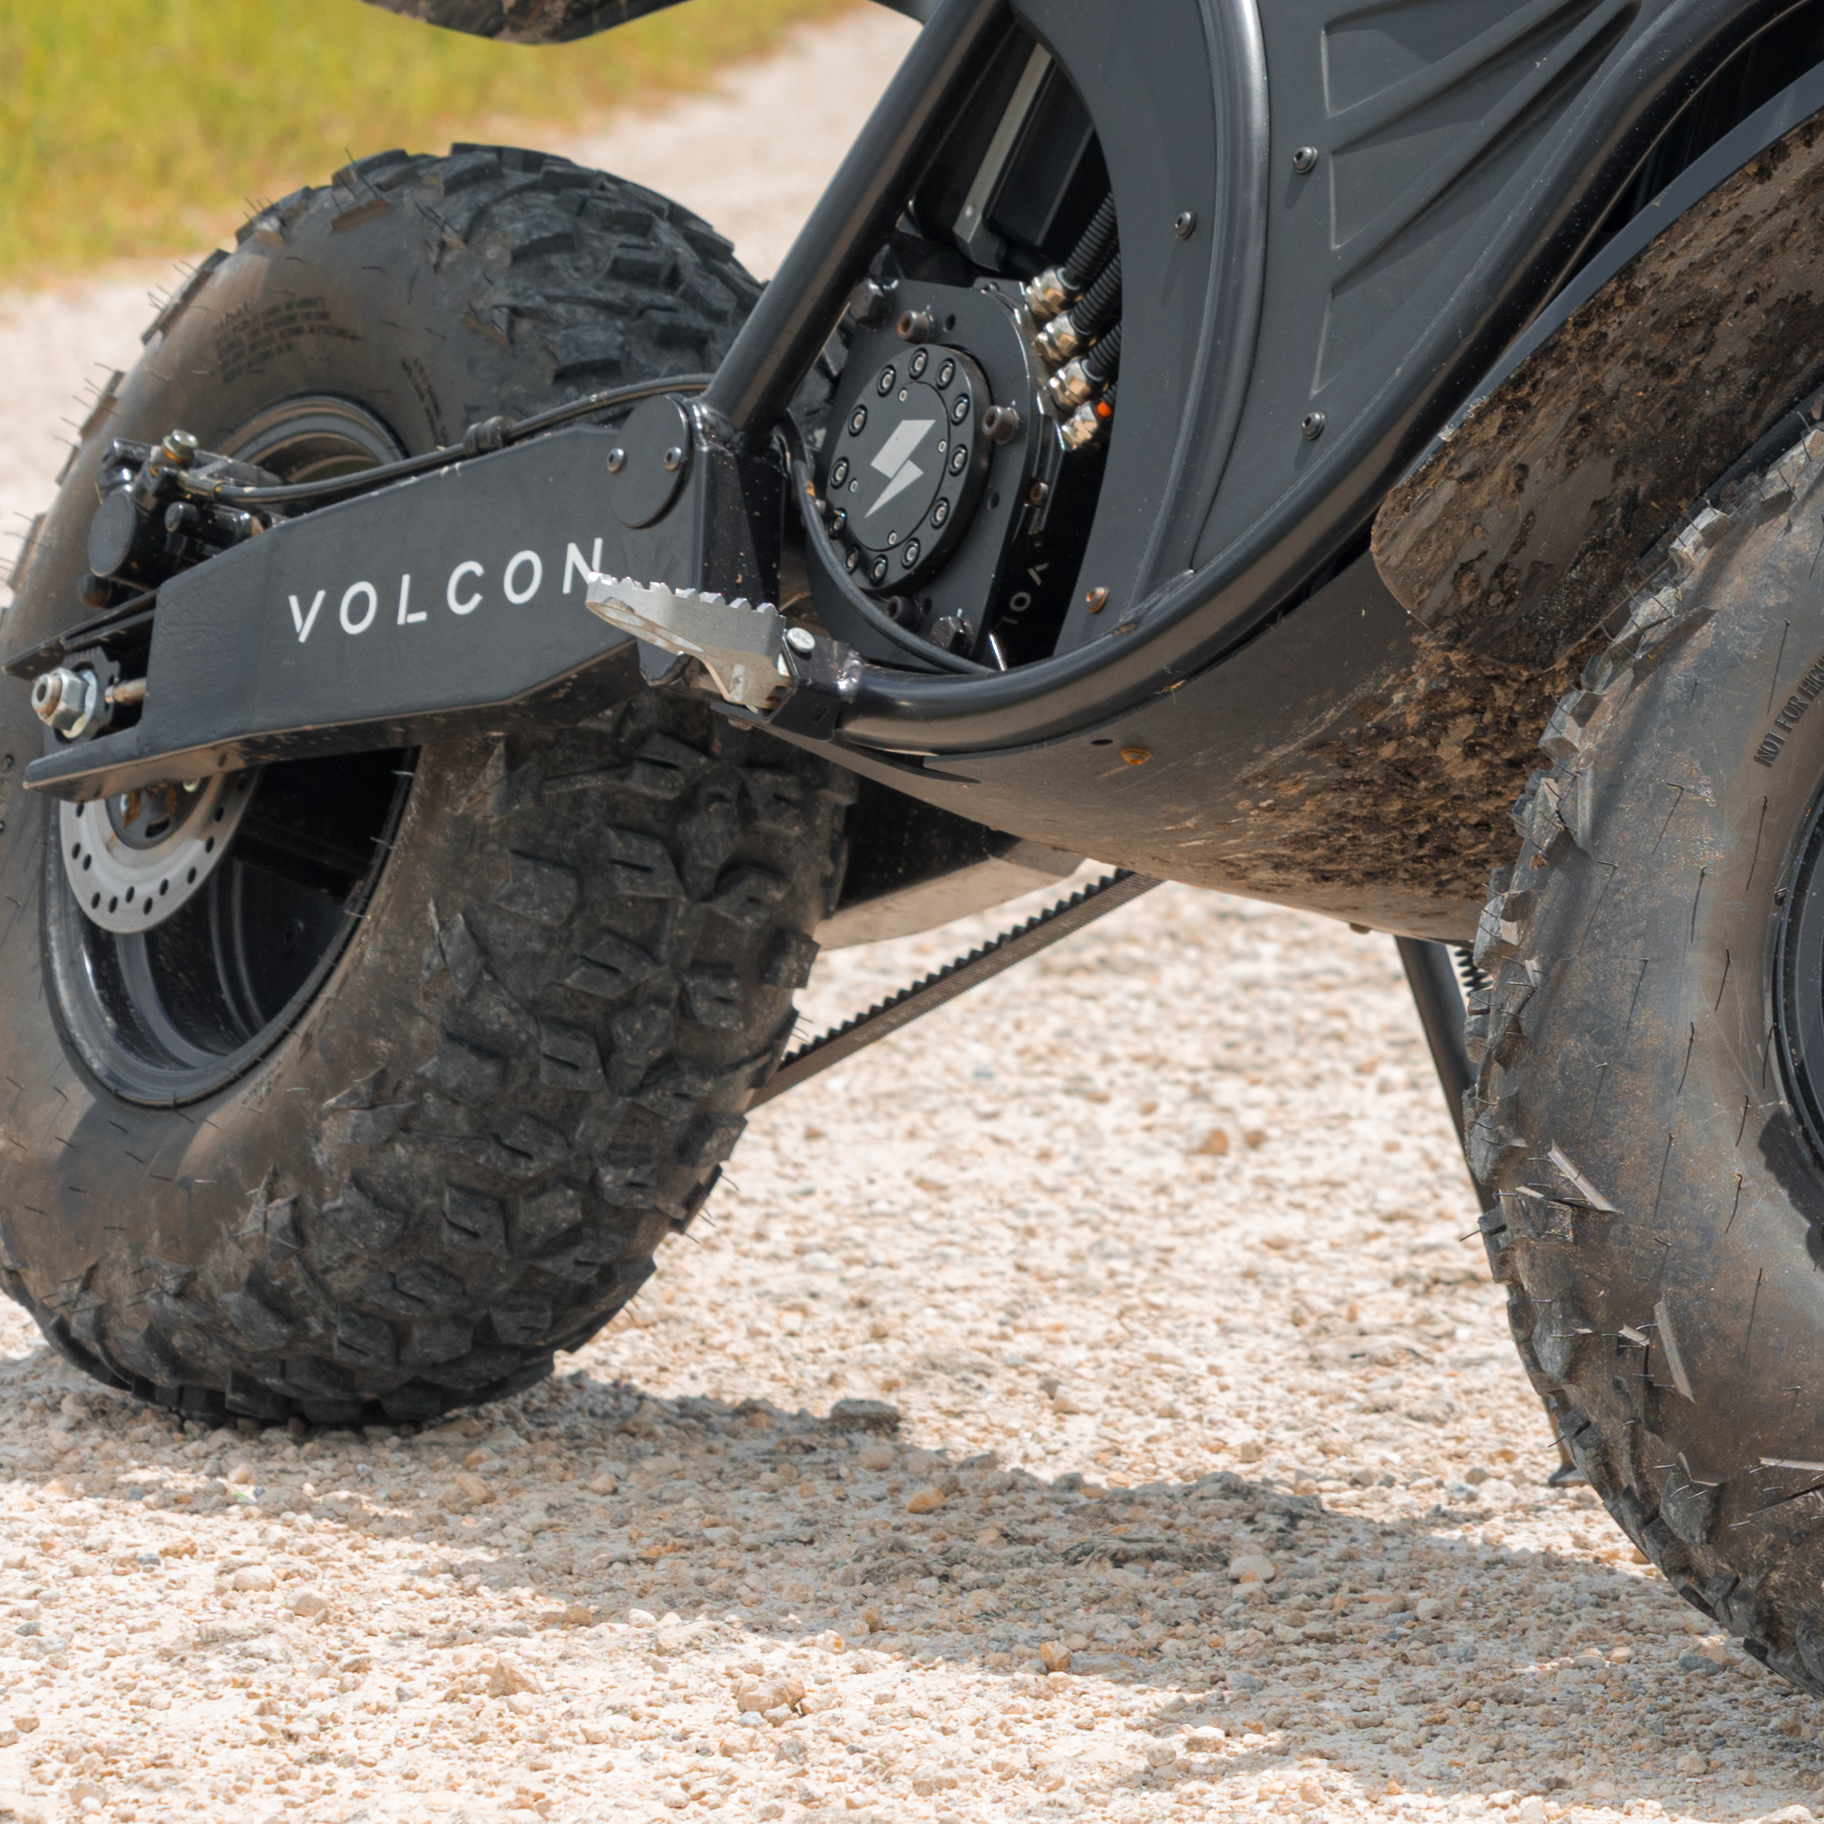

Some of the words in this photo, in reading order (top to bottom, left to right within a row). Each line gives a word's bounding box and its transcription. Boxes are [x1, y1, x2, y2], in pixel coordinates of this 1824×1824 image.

[288, 537, 603, 643] VOLCON
[1754, 729, 1787, 768] NOT
[1775, 695, 1809, 733] FOR
